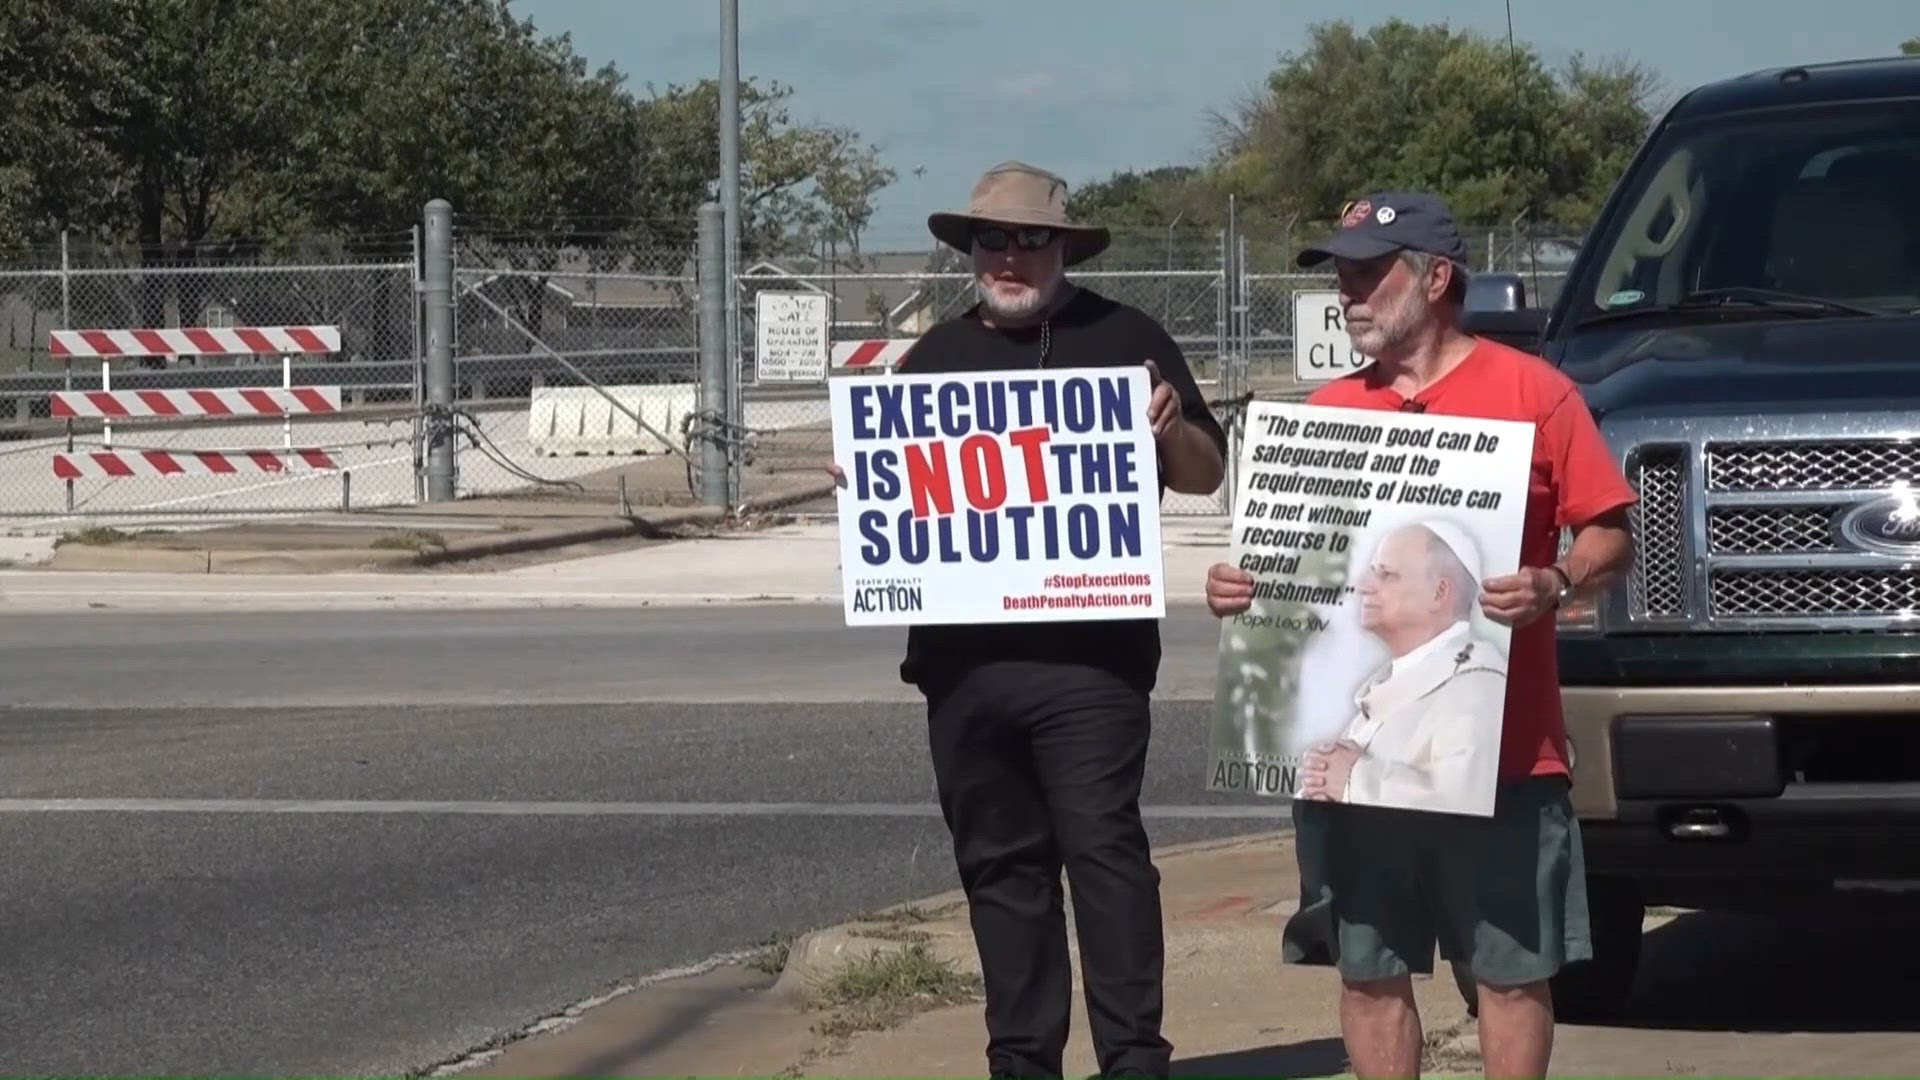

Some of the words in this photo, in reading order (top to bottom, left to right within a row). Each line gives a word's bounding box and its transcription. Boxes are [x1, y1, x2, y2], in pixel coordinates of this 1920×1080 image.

[849, 377, 1133, 440] EXECUTION
[1302, 419, 1384, 445] common
[1384, 427, 1435, 448] good
[1436, 431, 1472, 452] can
[1473, 431, 1500, 454] be
[854, 449, 901, 501] IS
[904, 426, 1051, 518] NOT
[1050, 442, 1139, 495] THE
[1252, 443, 1369, 471] safeguarded
[1370, 453, 1407, 475] and
[1409, 454, 1441, 477] the
[1248, 471, 1374, 499] requirements
[1375, 480, 1398, 502] of
[1396, 480, 1464, 508] justice
[1465, 489, 1502, 510] can
[1244, 498, 1268, 519] be
[1269, 503, 1305, 522] met
[1307, 504, 1372, 528] without
[858, 503, 1142, 566] SOLUTION
[1241, 526, 1326, 551] recourse
[1328, 531, 1350, 553] to
[1239, 552, 1302, 575] capital
[855, 578, 882, 586] DEATH
[1043, 572, 1151, 589] #StopExecutions
[853, 585, 923, 613] ACTION
[1002, 593, 1153, 610] DeathPenaltyAction.org
[1234, 612, 1273, 630] Pope
[1275, 615, 1302, 631] Leo
[1304, 618, 1330, 633] XIV
[1212, 760, 1297, 793] ACTION
